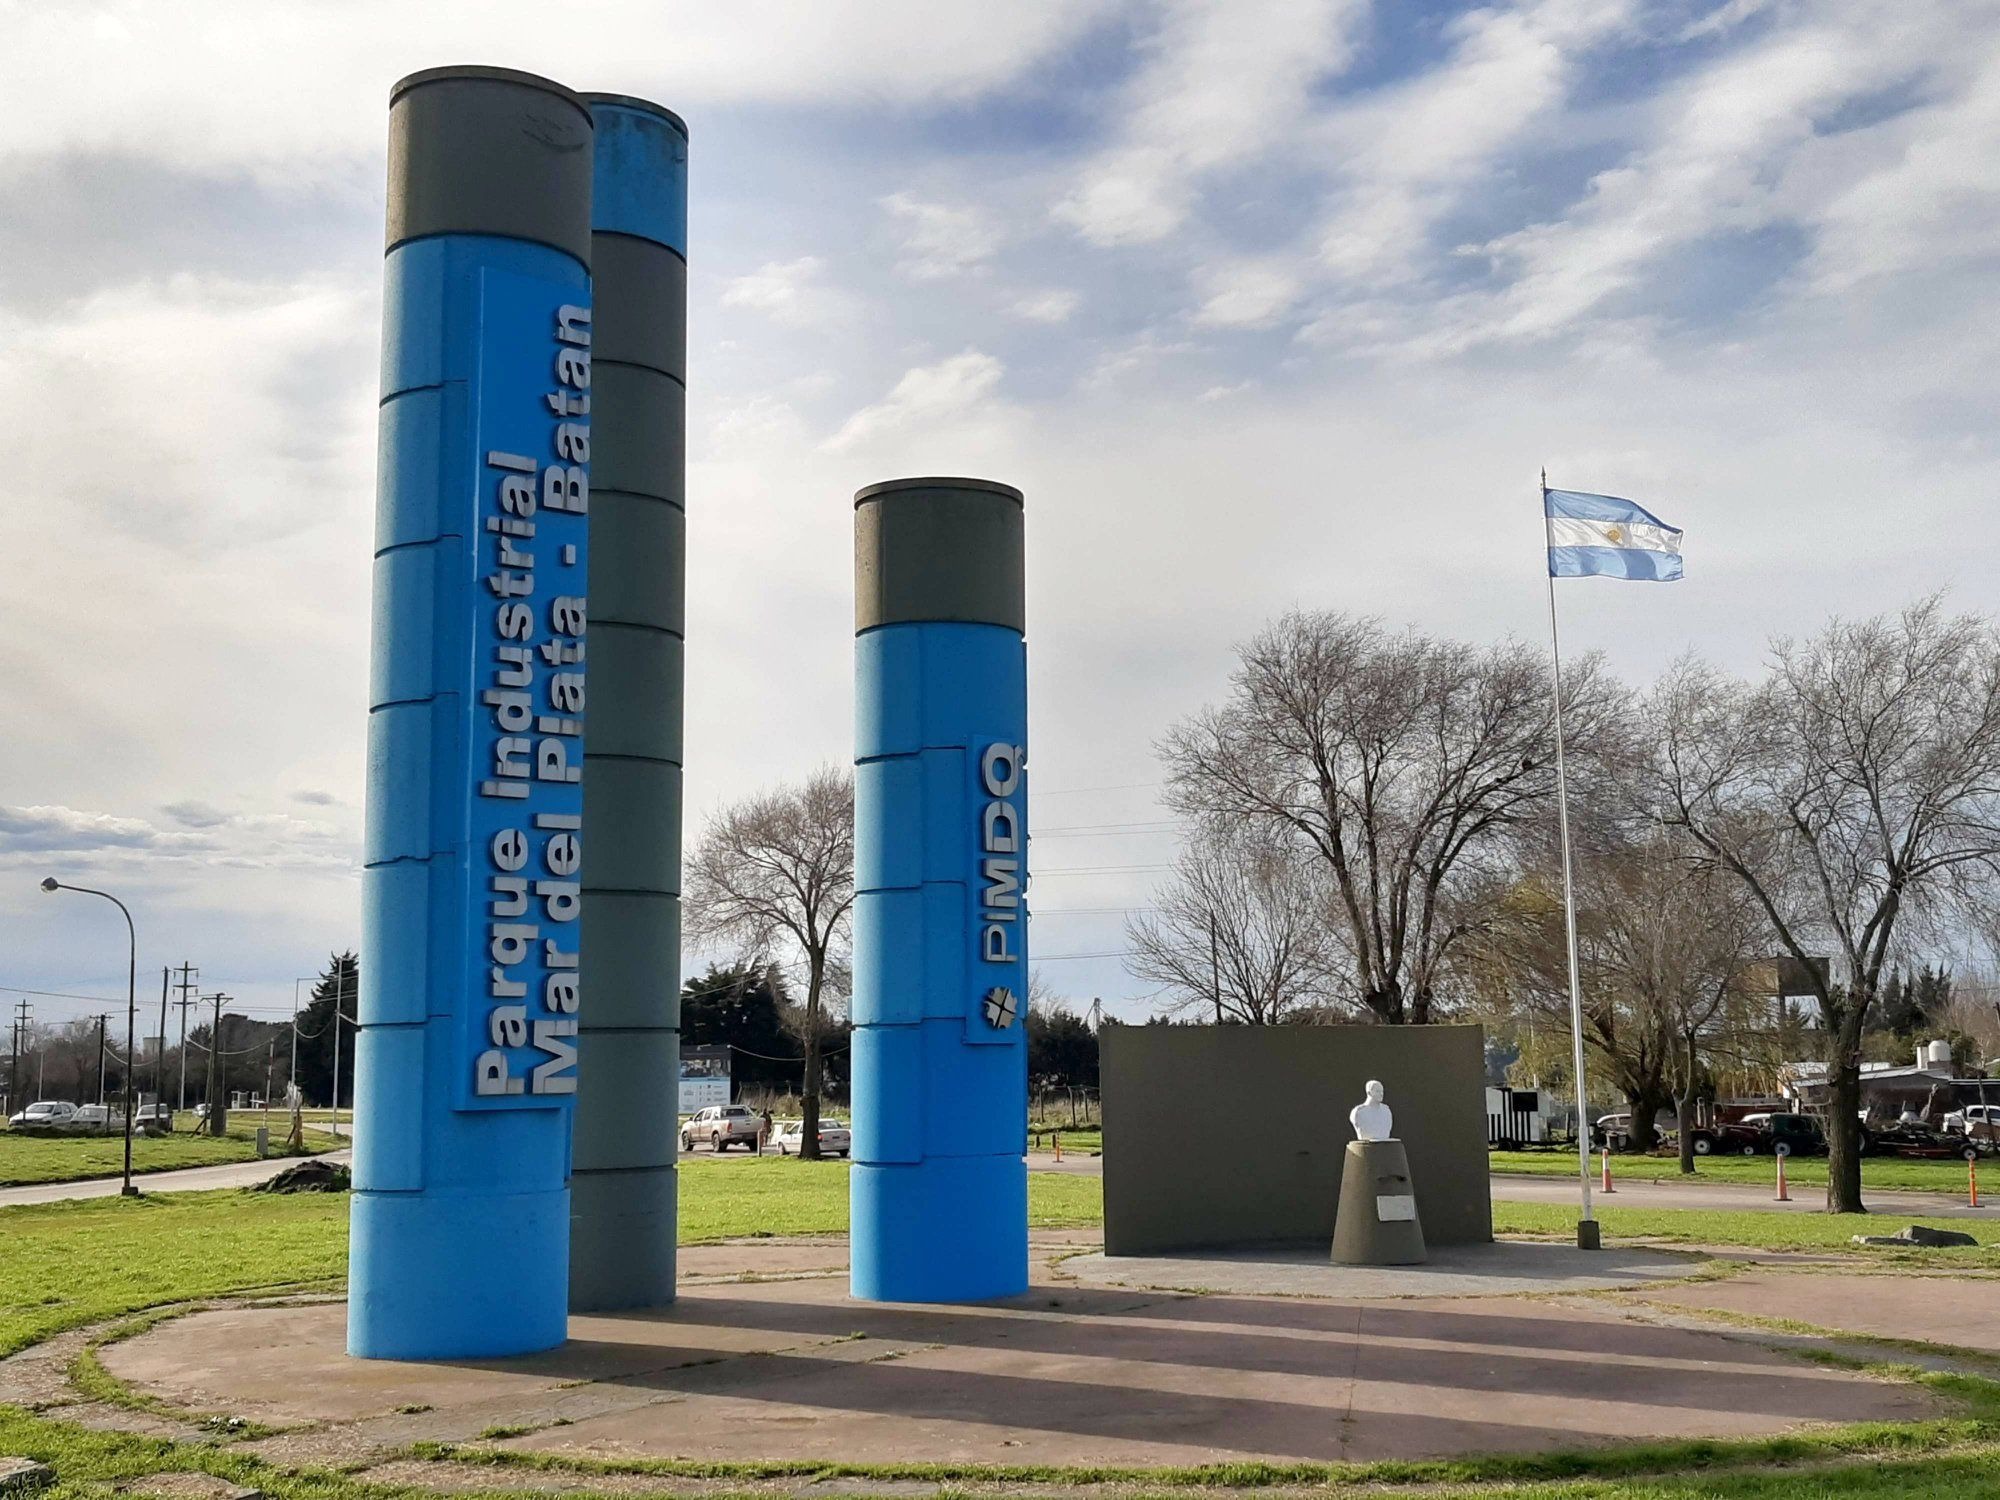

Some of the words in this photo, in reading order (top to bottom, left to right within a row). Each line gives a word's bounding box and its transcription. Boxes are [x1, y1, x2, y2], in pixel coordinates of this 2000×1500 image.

[543, 303, 592, 515] Batan
[481, 450, 538, 799] Industrial
[562, 543, 577, 565] -
[536, 595, 587, 784] Plata
[535, 812, 582, 923] del
[982, 741, 1025, 963] PIMDQ
[475, 827, 539, 1096] Parque
[531, 939, 580, 1095] Mar
